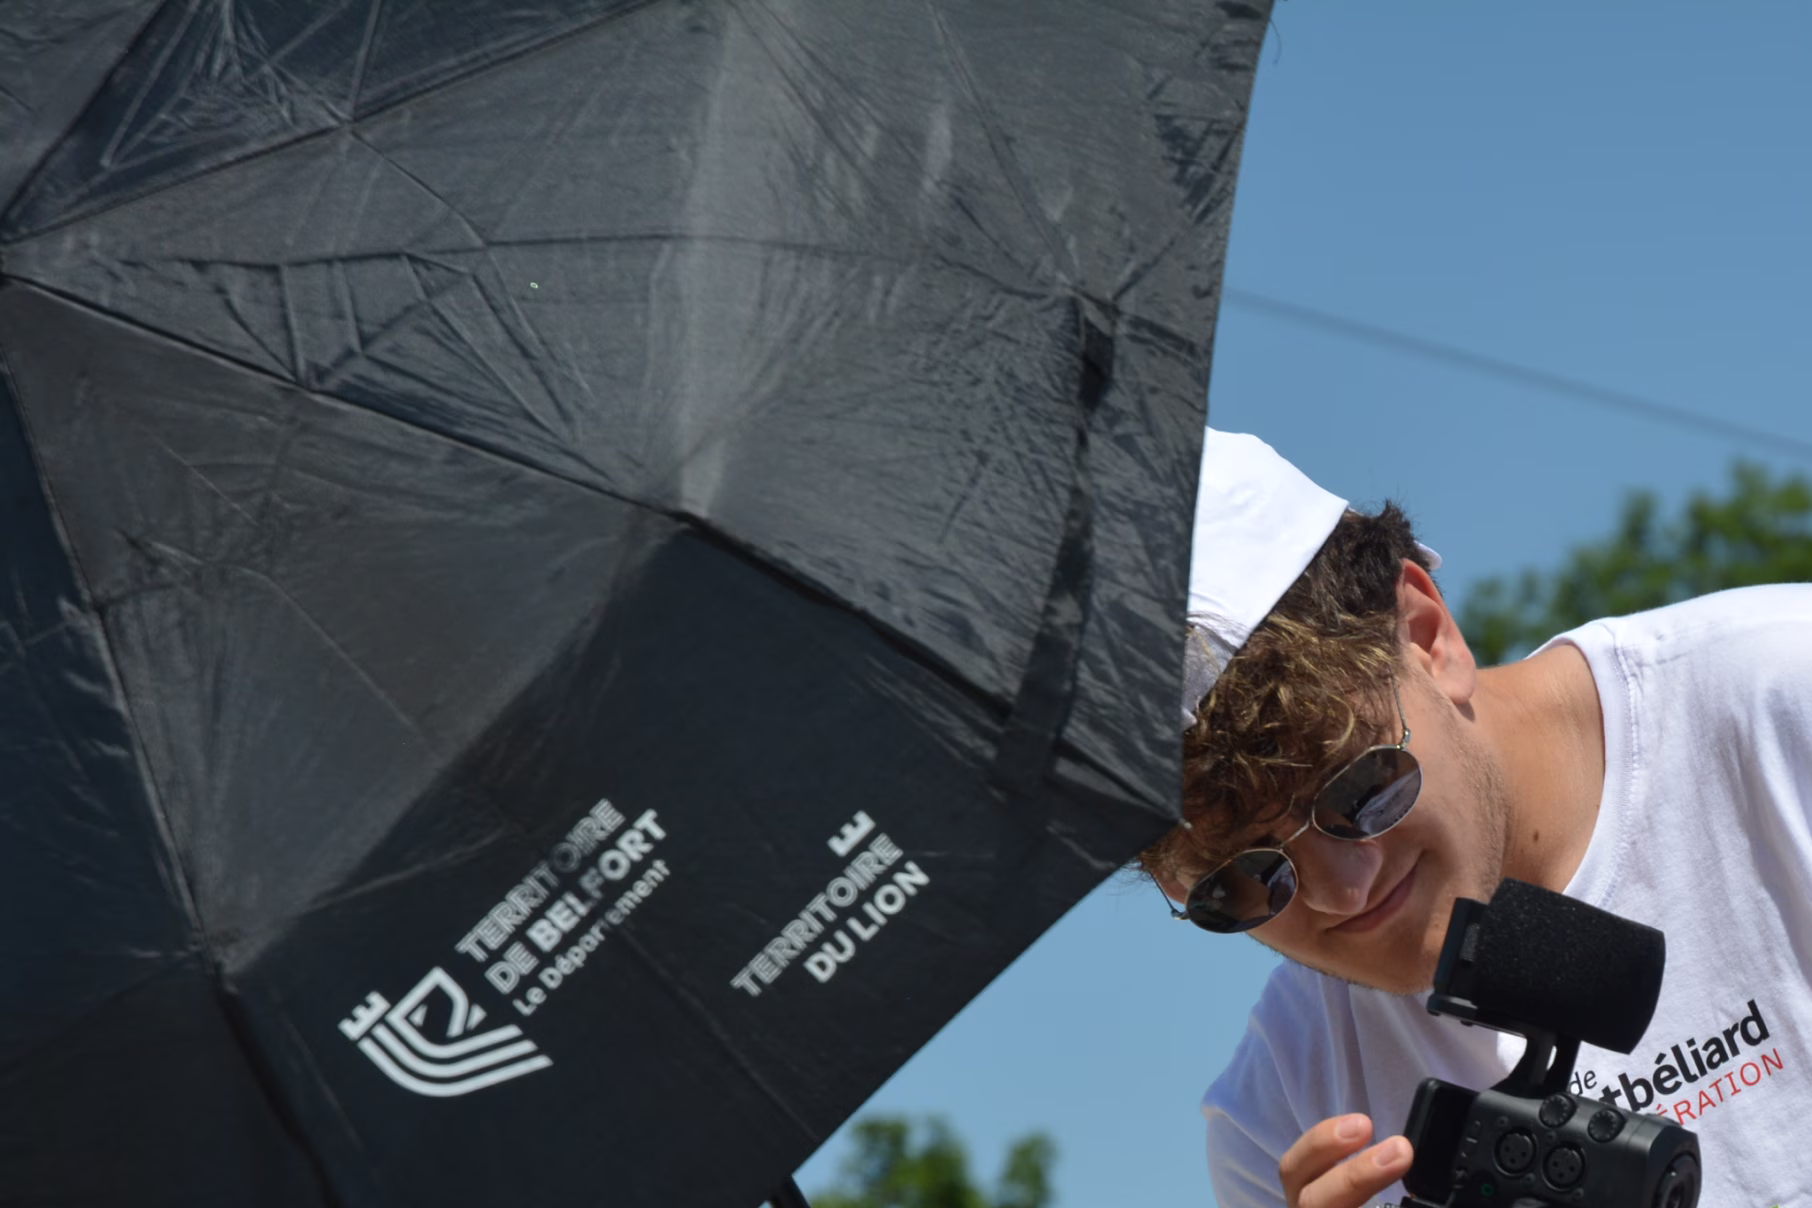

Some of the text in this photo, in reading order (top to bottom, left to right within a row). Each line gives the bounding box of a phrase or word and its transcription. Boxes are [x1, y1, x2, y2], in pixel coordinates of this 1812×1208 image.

[454, 798, 626, 964] TERRITOIRE
[484, 808, 667, 995] DE BELFORT
[512, 858, 671, 1017] Le Département
[730, 832, 904, 997] TERRITOIRE
[803, 860, 930, 983] DU LION
